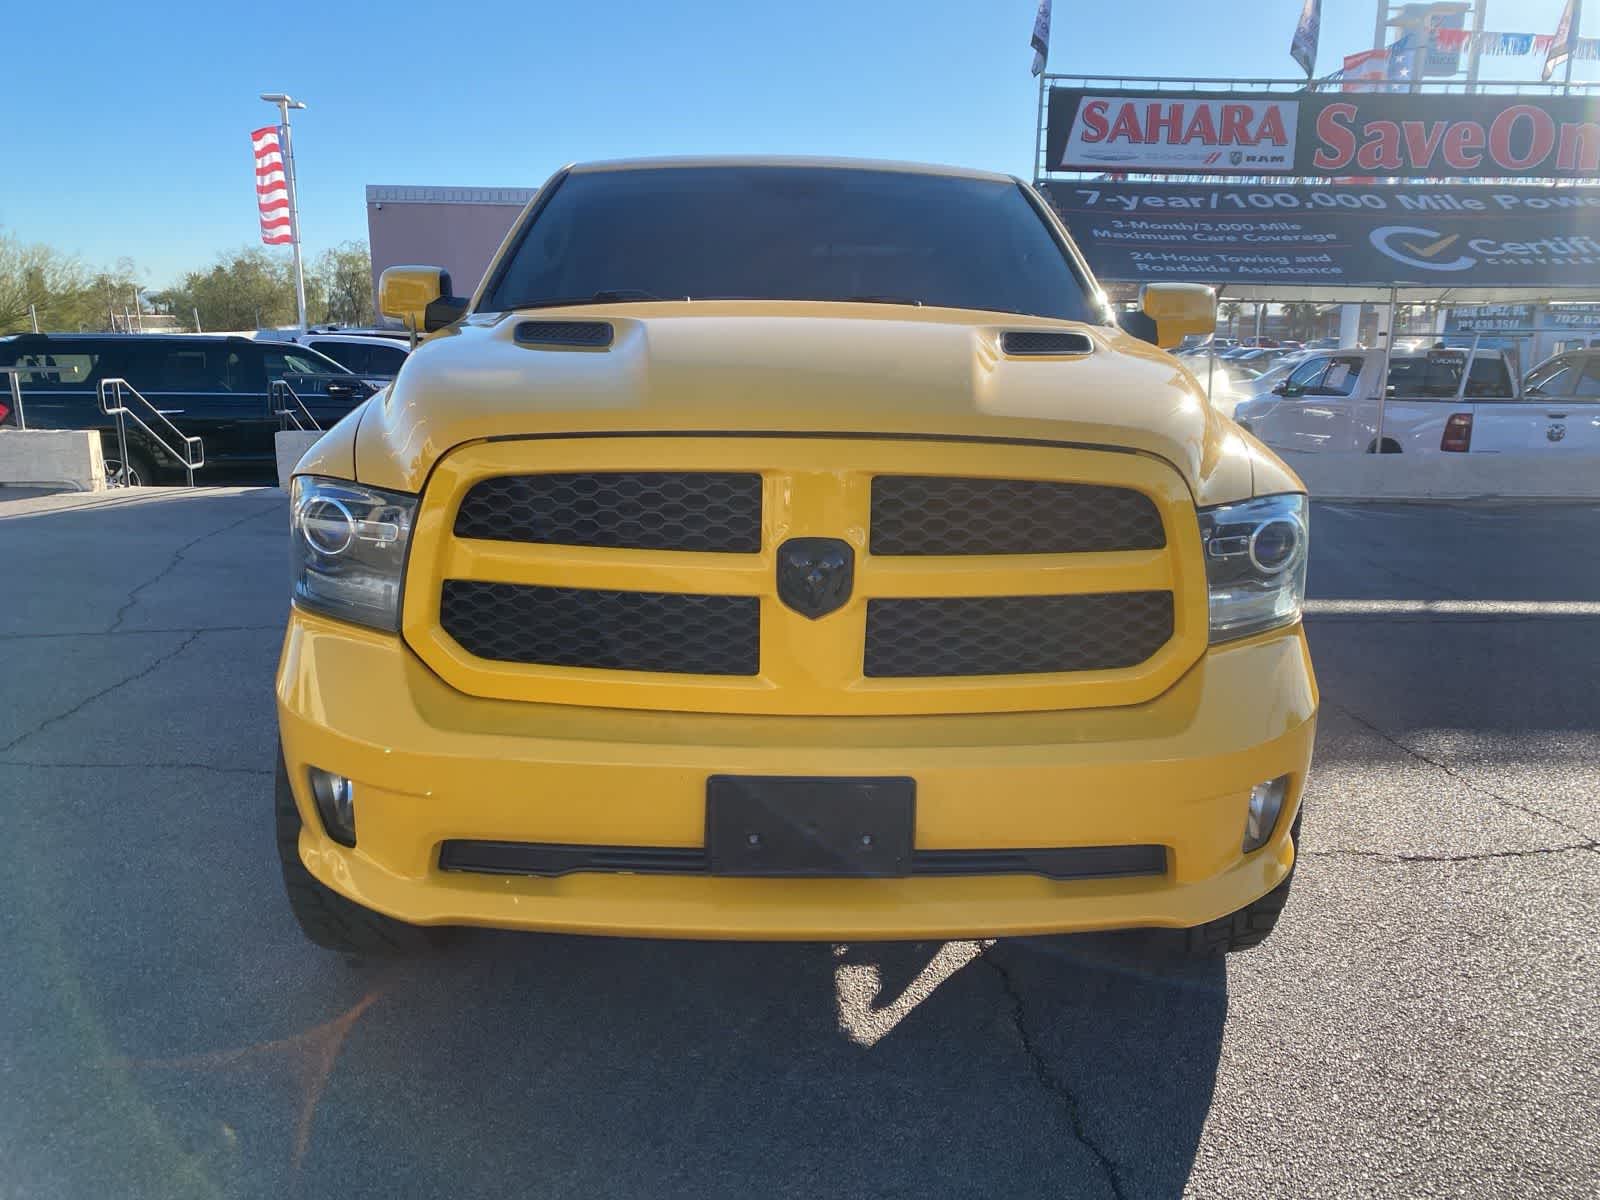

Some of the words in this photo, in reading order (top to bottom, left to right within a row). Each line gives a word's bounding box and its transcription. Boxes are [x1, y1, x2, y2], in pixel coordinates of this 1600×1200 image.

[1081, 100, 1288, 146] SAHARA
[1395, 194, 1486, 210] Mile
[1093, 229, 1187, 241] Maximum
[1192, 232, 1238, 242] Care
[1243, 232, 1337, 243] Coverage
[1130, 251, 1210, 263] 24-Hour
[1216, 254, 1290, 265] Towing
[1295, 254, 1332, 263] and
[1136, 263, 1231, 274] Roadside
[1237, 265, 1344, 275] Assistance
